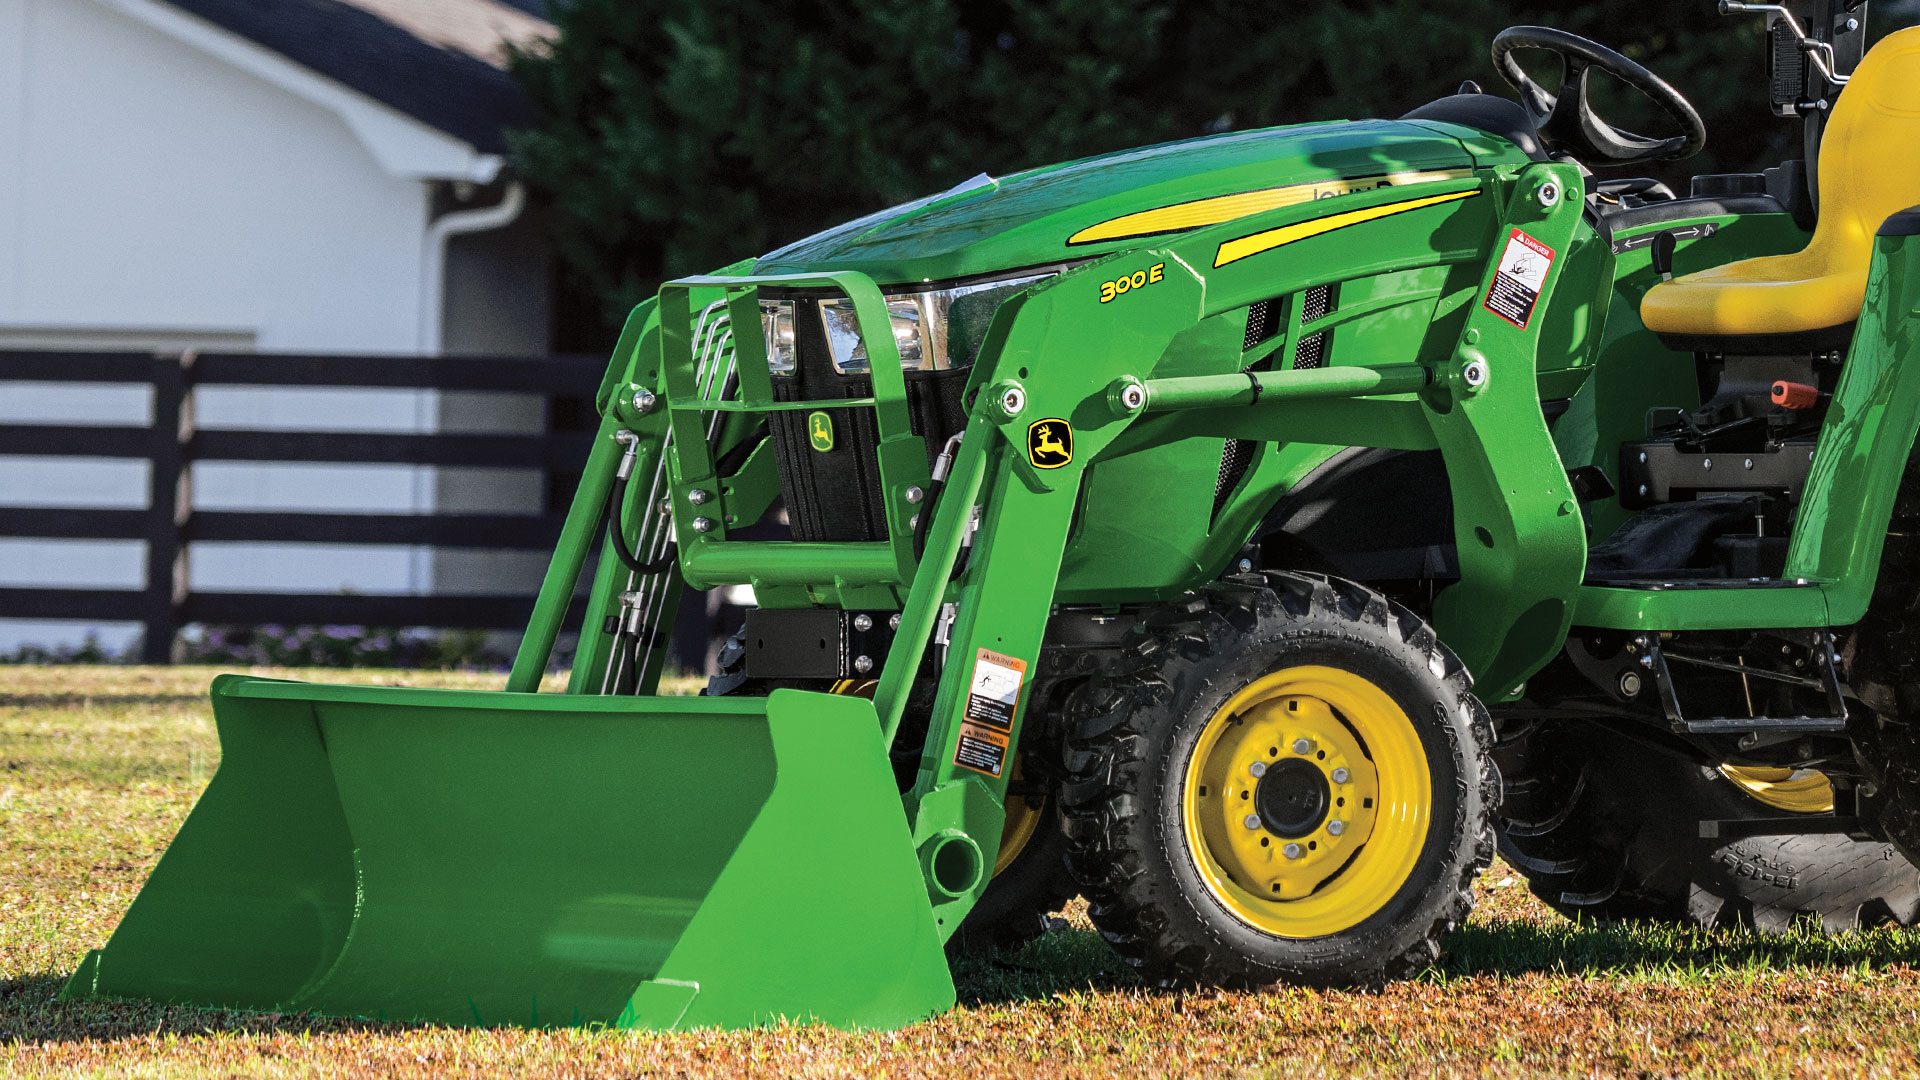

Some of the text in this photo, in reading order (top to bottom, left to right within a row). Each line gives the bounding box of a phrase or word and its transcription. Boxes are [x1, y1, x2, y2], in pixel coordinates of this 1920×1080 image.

[1523, 237, 1550, 257] DANGER
[990, 654, 1021, 669] WARNING
[973, 730, 1004, 745] WARNING
[1434, 701, 1469, 863] GALAXY
